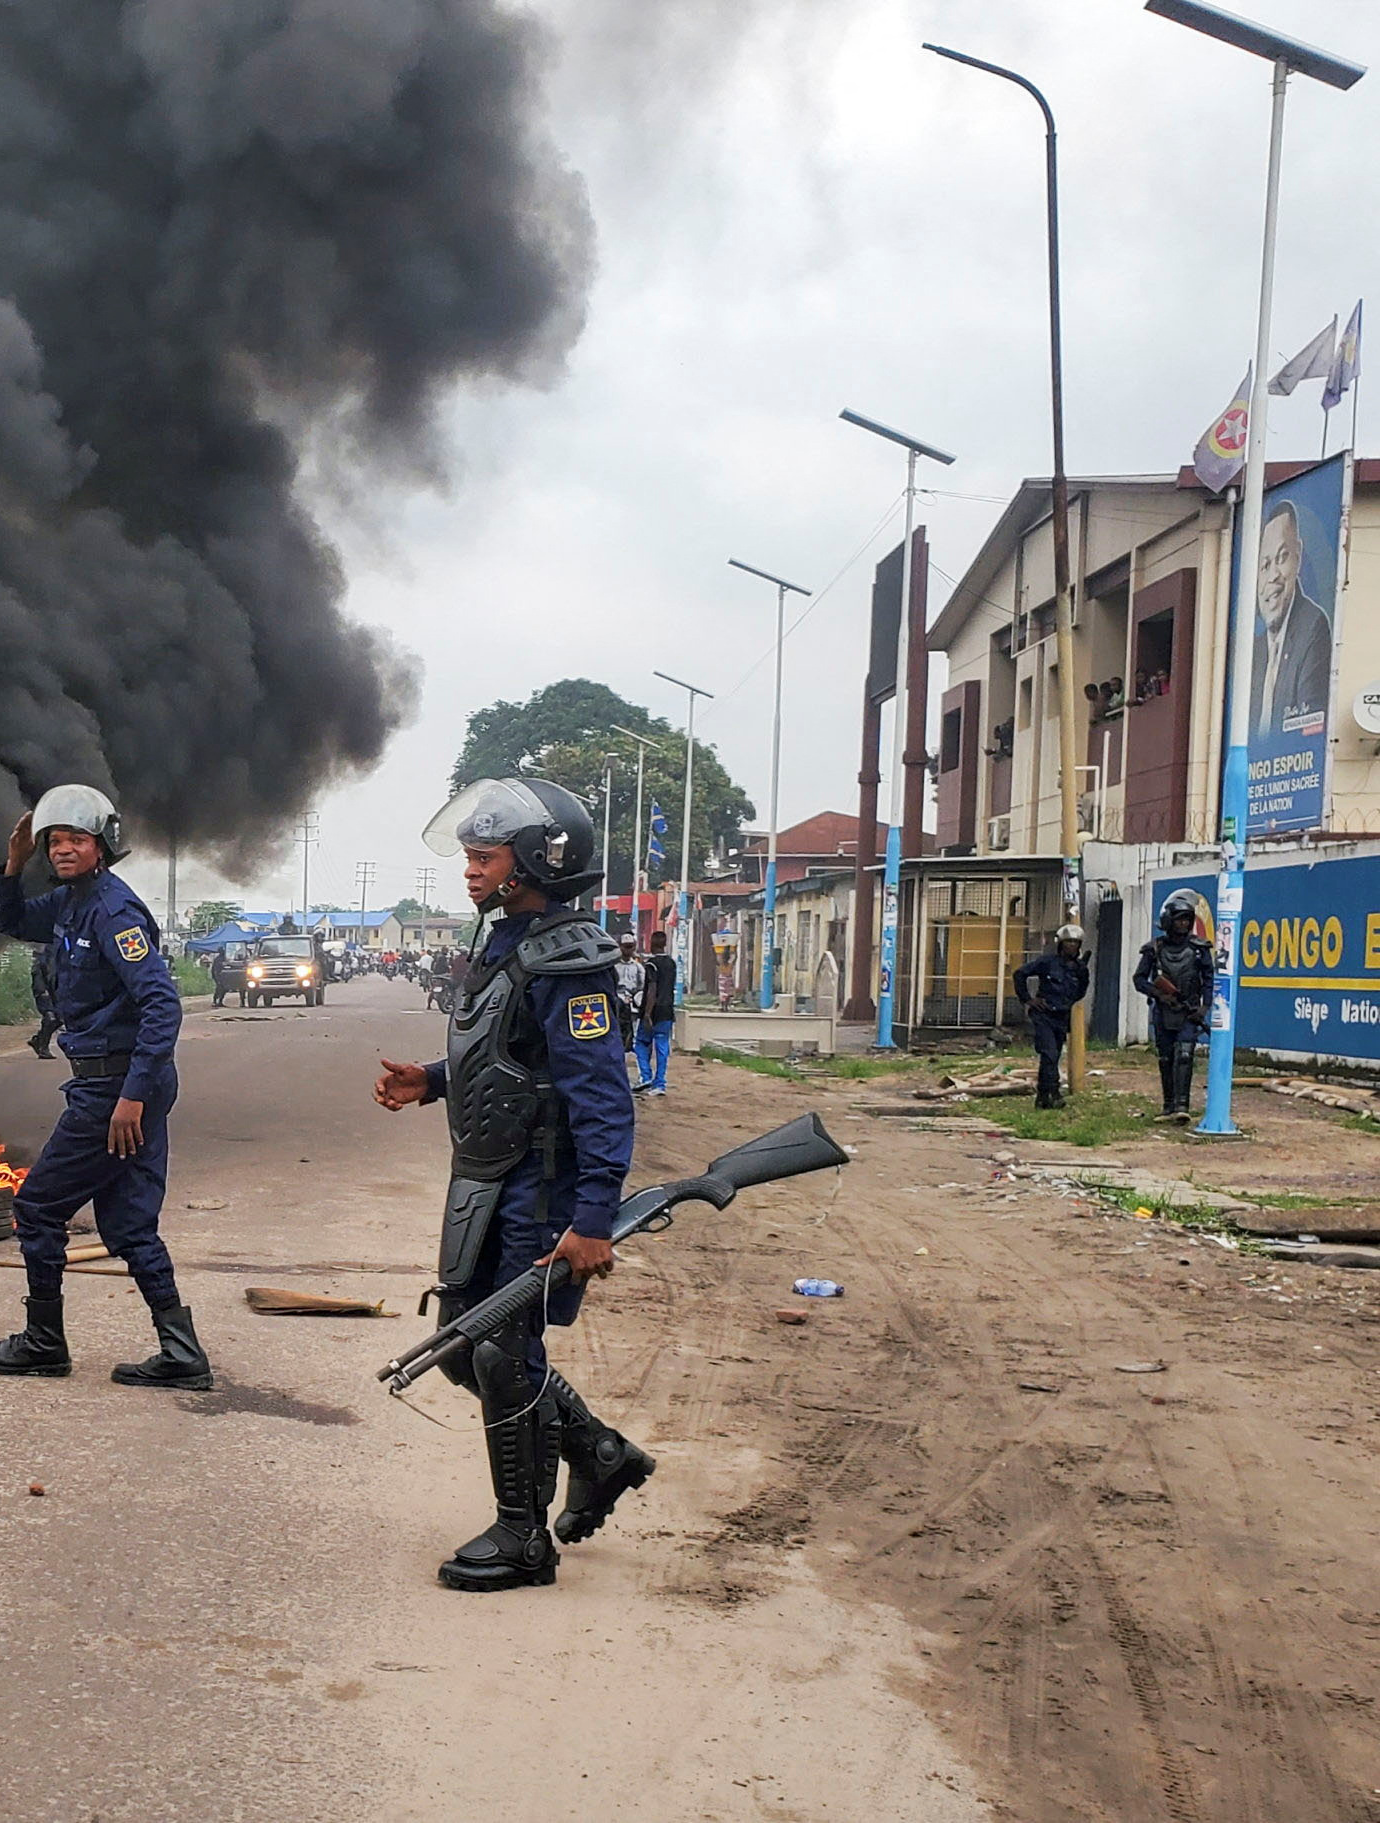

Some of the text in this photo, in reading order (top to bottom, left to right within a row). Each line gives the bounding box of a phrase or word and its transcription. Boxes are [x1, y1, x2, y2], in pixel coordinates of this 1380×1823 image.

[1248, 751, 1314, 780] NGO ESPOIR
[1255, 784, 1264, 798] DE
[1291, 771, 1320, 792] SACRÉE
[1249, 797, 1293, 816] DE LA NATION
[1242, 916, 1343, 969] CONGO
[571, 996, 604, 1007] POLICE
[1294, 996, 1380, 1034] Siège Natio
